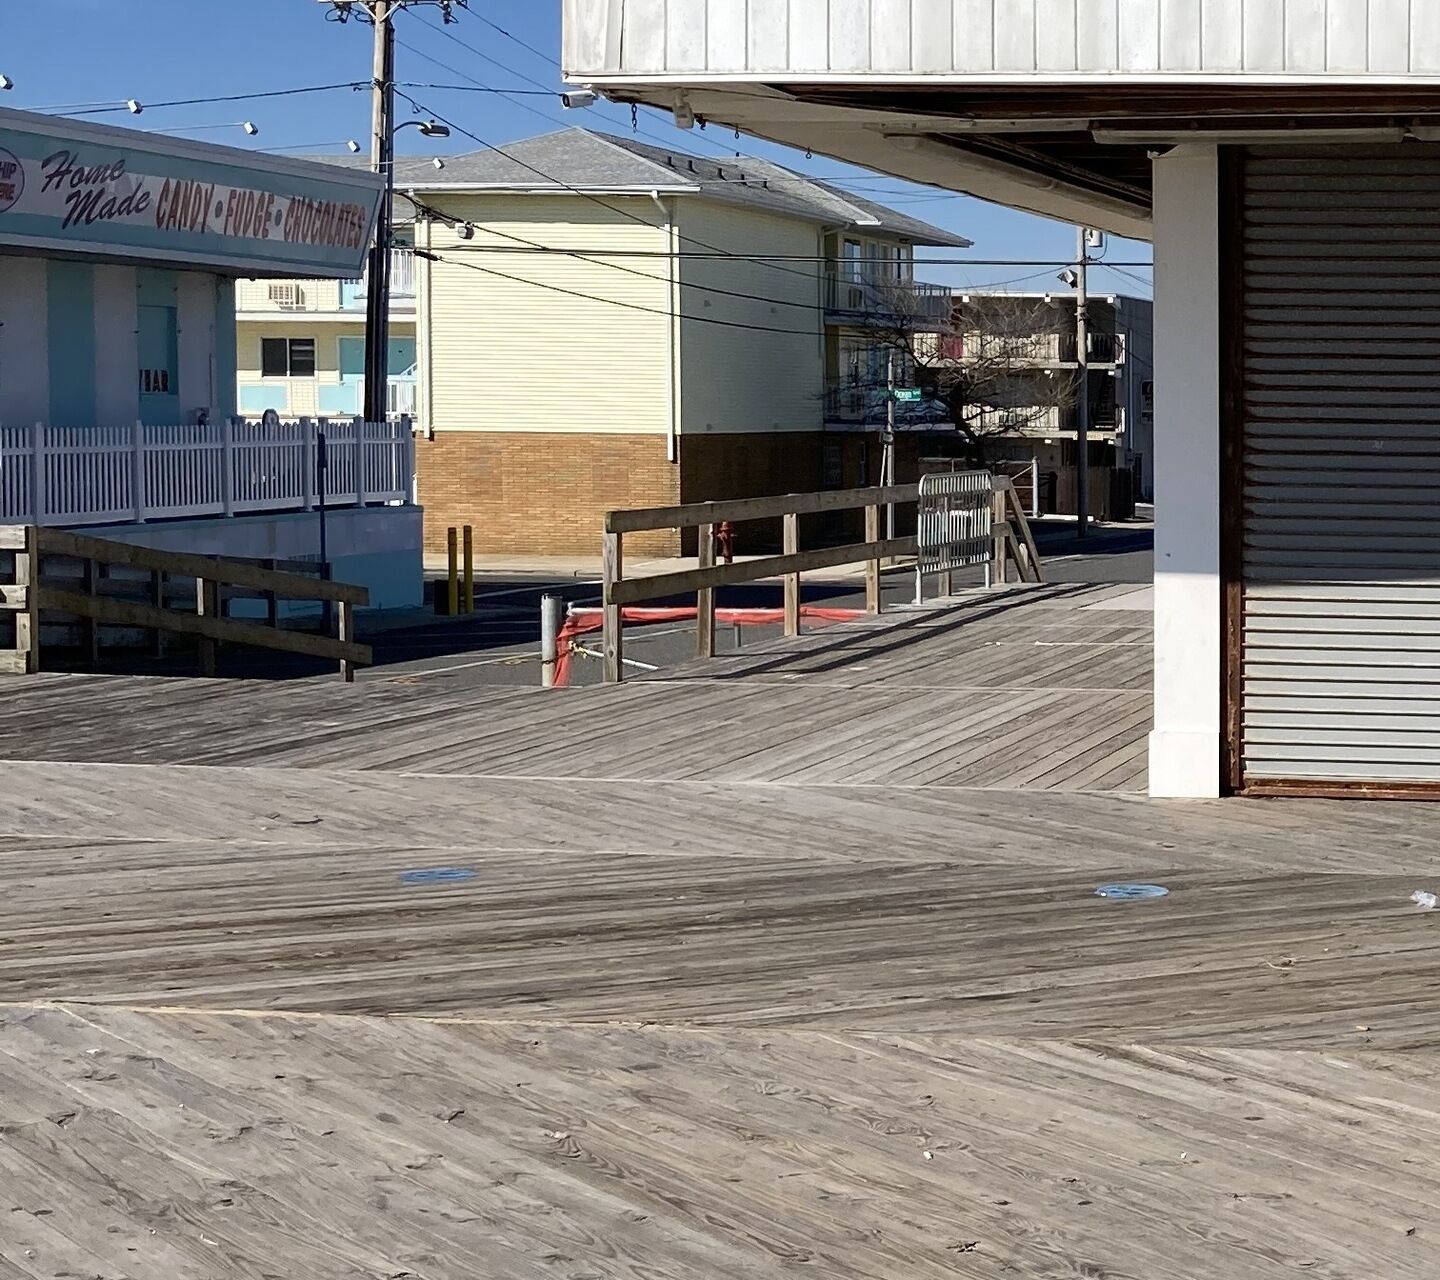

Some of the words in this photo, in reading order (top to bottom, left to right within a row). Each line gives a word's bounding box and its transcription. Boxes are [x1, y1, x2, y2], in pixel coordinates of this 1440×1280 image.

[41, 150, 126, 193] Home
[62, 181, 153, 230] Made
[155, 176, 215, 234] CANDY
[224, 188, 275, 239] FUDGE
[284, 194, 367, 250] CHOCOLATES
